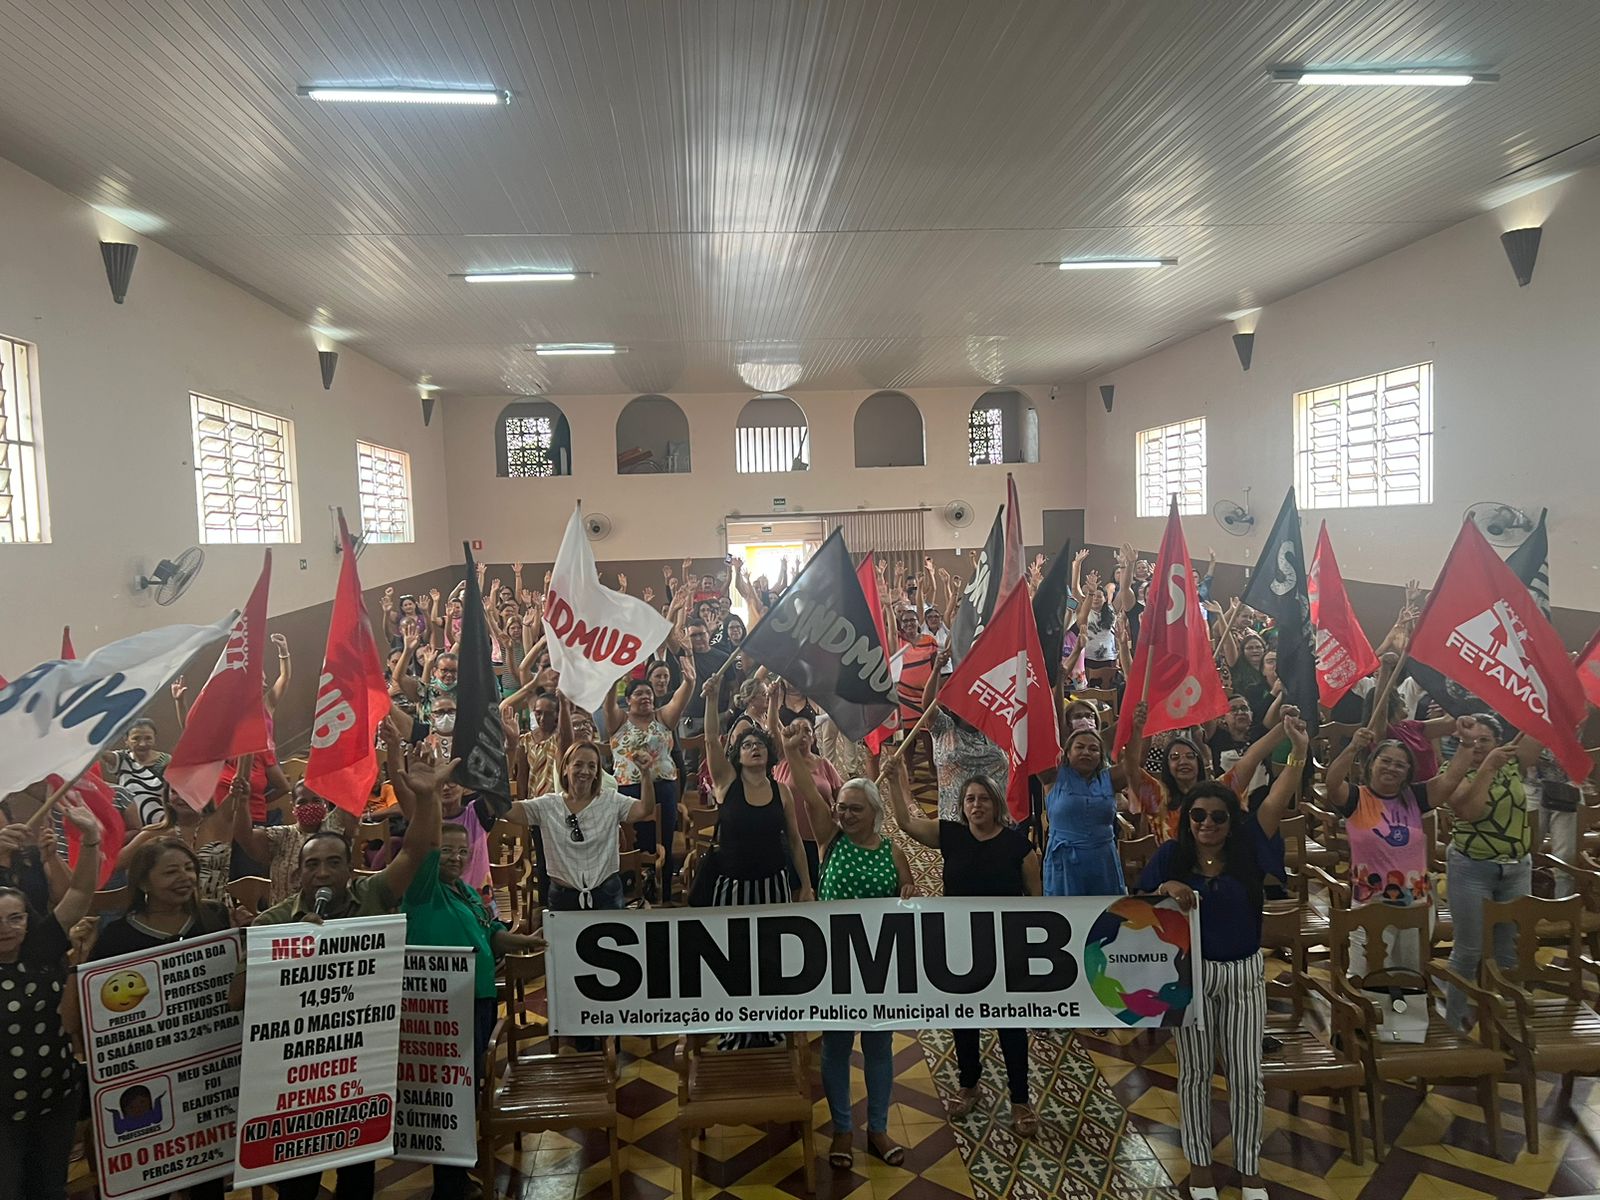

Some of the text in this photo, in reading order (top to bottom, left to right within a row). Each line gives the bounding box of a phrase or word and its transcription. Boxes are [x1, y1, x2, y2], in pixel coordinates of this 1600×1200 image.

[771, 591, 899, 703] SINDMU
[1445, 632, 1552, 723] FETAMC
[968, 680, 1016, 728] FETA
[161, 944, 226, 970] NOTÍCIA BOA
[272, 933, 386, 960] MEC ANUNCIA
[574, 910, 1078, 1001] SINDMUB
[1109, 952, 1168, 964] SINDMUB
[163, 965, 206, 985] PARA OS
[280, 959, 376, 986] REAJUSTE DE
[404, 956, 468, 972] LHA SAI NA
[165, 972, 234, 1001] PROFESSORES
[300, 985, 354, 1008] 14,95%
[402, 976, 447, 993] ENTE NO
[166, 989, 228, 1016] EFETIVOS DE
[401, 997, 448, 1014] SMONTE
[581, 1002, 1080, 1028] Pela Valorização do Servidor Publico Municipal de Barbalha-CE
[96, 1003, 231, 1048] BARBALHA. VOU REAJUSTA
[109, 1010, 146, 1027] PREFEITO
[250, 1004, 395, 1042] PARA O MAGISTÉRIO
[400, 1018, 459, 1036] ARIAL DOS
[97, 1052, 105, 1064] O
[108, 1038, 154, 1061] SALÁRIO
[156, 1035, 172, 1048] EM
[214, 1016, 240, 1032] PARA
[283, 1031, 363, 1060] BARBALHA
[400, 1040, 460, 1058] FESSORES.
[99, 1060, 138, 1079] TODOS.
[178, 1067, 200, 1083] MEU
[287, 1056, 358, 1084] CONCEDE
[397, 1062, 472, 1087] DA DE 37%
[205, 1076, 221, 1090] FOI
[276, 1078, 363, 1111] APENAS 6%
[182, 1086, 239, 1112] REAJUSTAD
[404, 1088, 453, 1107] SALÁRIO
[197, 1110, 212, 1124] EM
[245, 1096, 389, 1143] KD A VALORIZAÇÃO
[407, 1109, 458, 1130] ÚLTIMOS
[108, 1121, 236, 1175] KD O RESTANTE
[274, 1128, 360, 1162] PREFEITO ?
[410, 1134, 445, 1151] ANOS.
